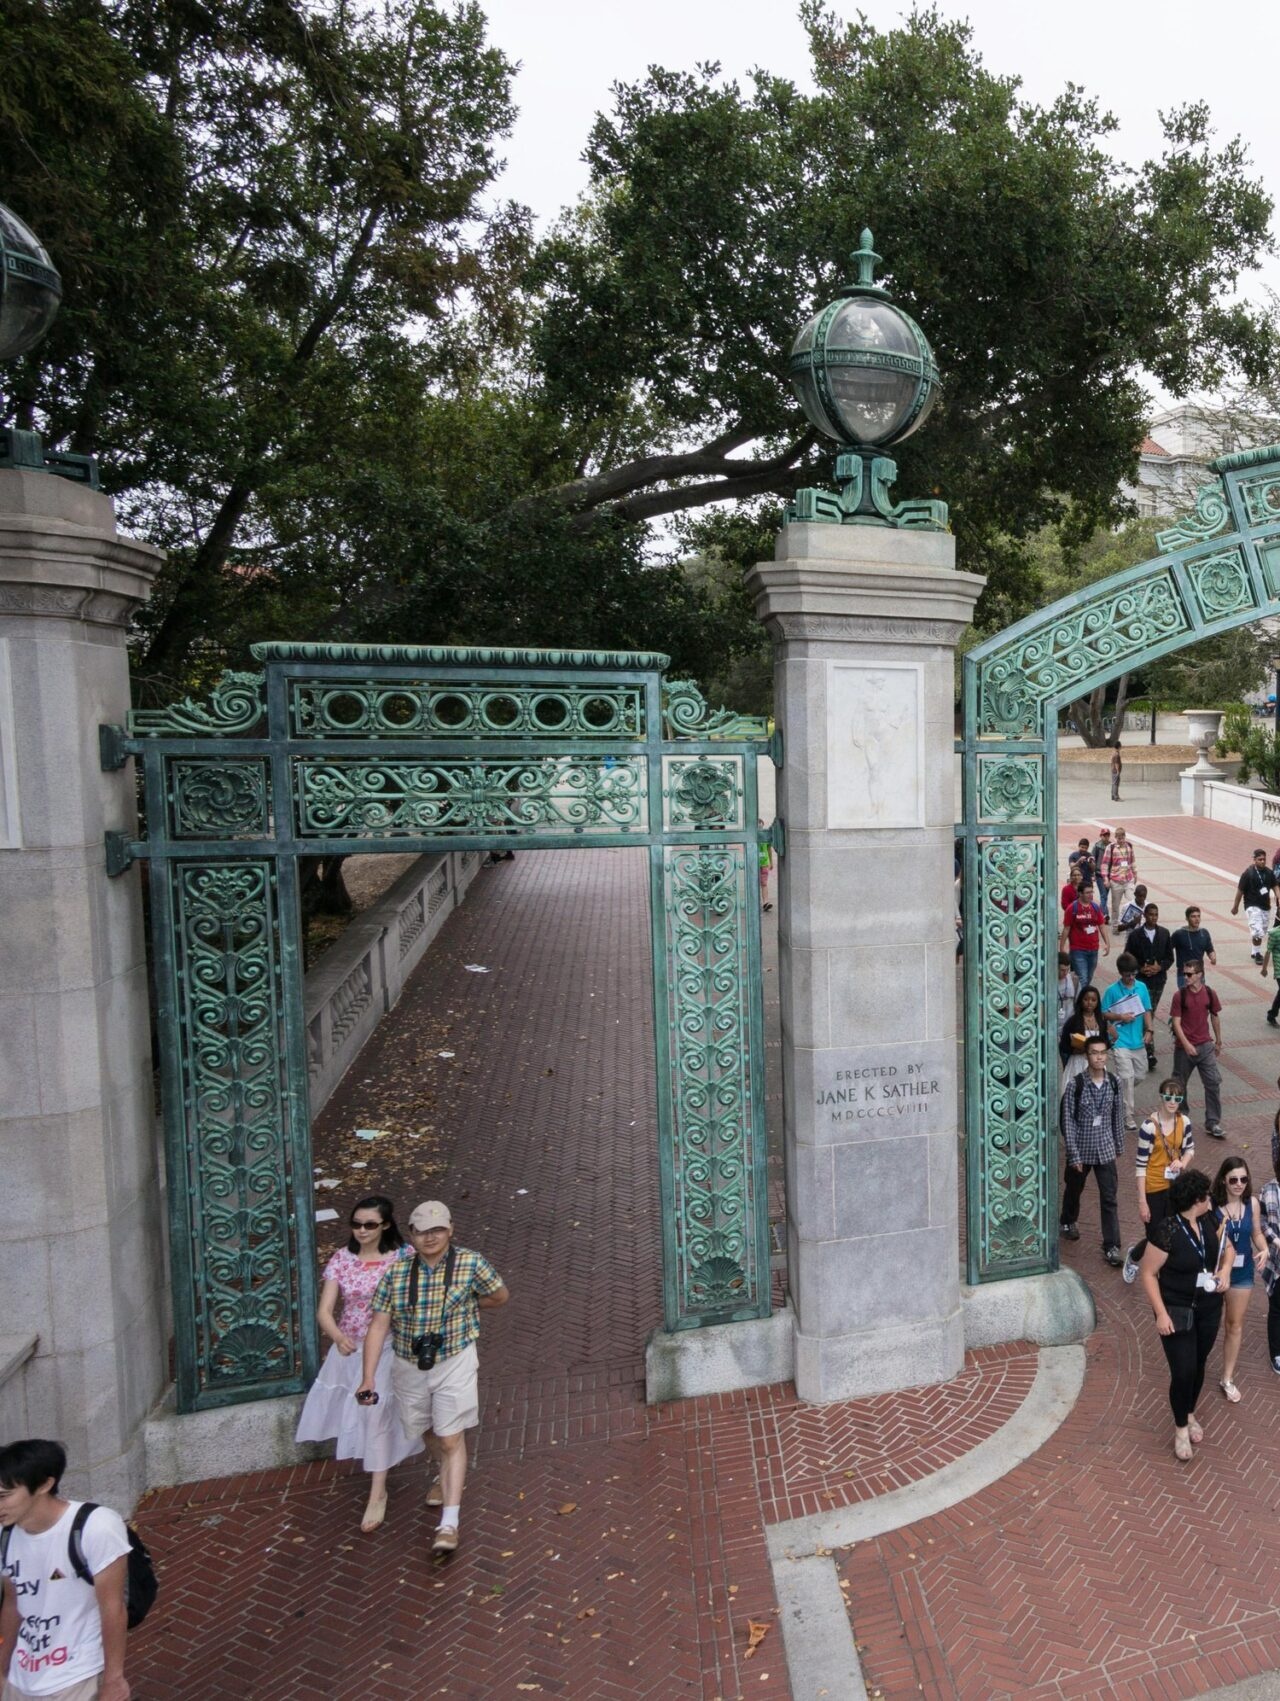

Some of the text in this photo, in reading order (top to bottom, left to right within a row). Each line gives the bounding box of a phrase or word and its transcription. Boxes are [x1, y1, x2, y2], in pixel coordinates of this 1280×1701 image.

[836, 1063, 924, 1080] ERECTED BY
[816, 1081, 940, 1106] JANE K SATHER
